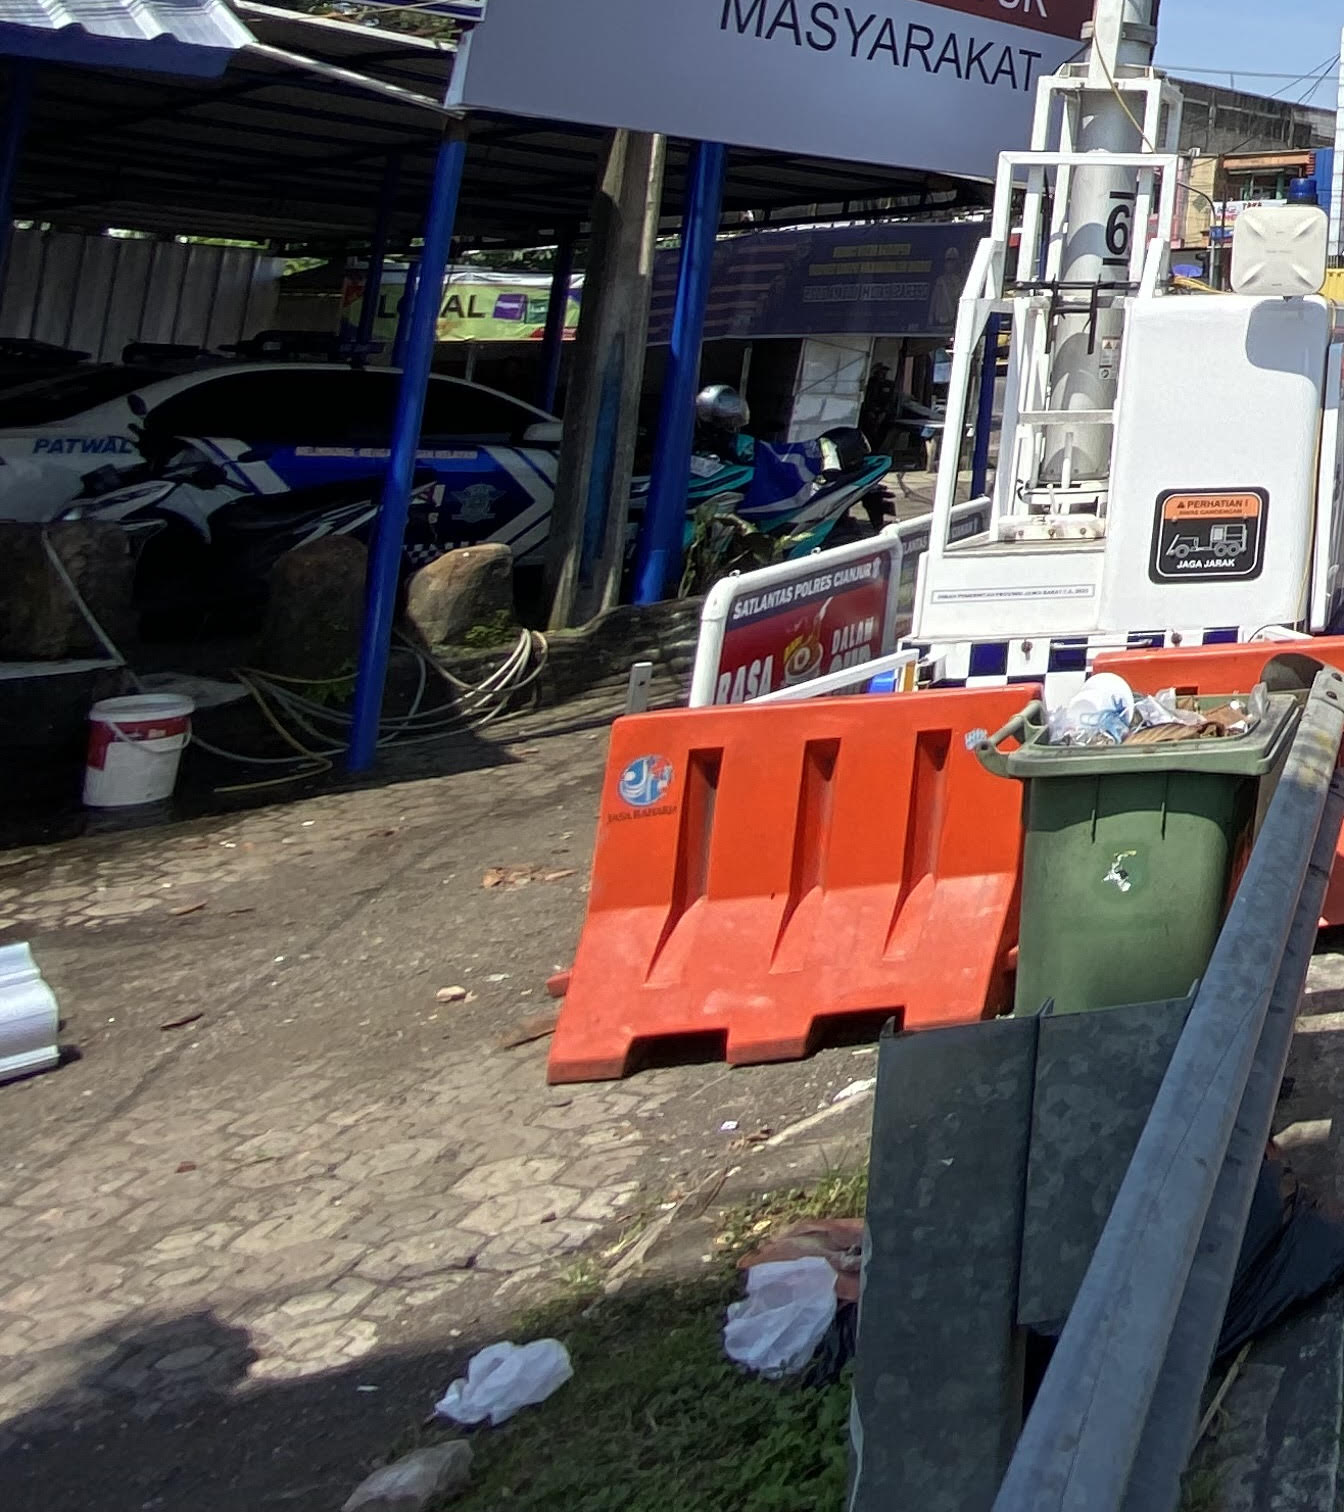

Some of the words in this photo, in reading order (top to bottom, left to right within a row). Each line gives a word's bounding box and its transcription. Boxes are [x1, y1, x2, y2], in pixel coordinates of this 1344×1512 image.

[1105, 203, 1130, 256] 6
[32, 436, 133, 454] PATWAL
[1187, 499, 1243, 509] PERHATIAN
[1176, 559, 1202, 569] JAGA
[1204, 558, 1235, 568] JARAK
[732, 585, 794, 621] SATLANTAS
[794, 573, 832, 601] POLRES
[833, 562, 872, 588] CIANJUR
[832, 616, 875, 656] DALAM
